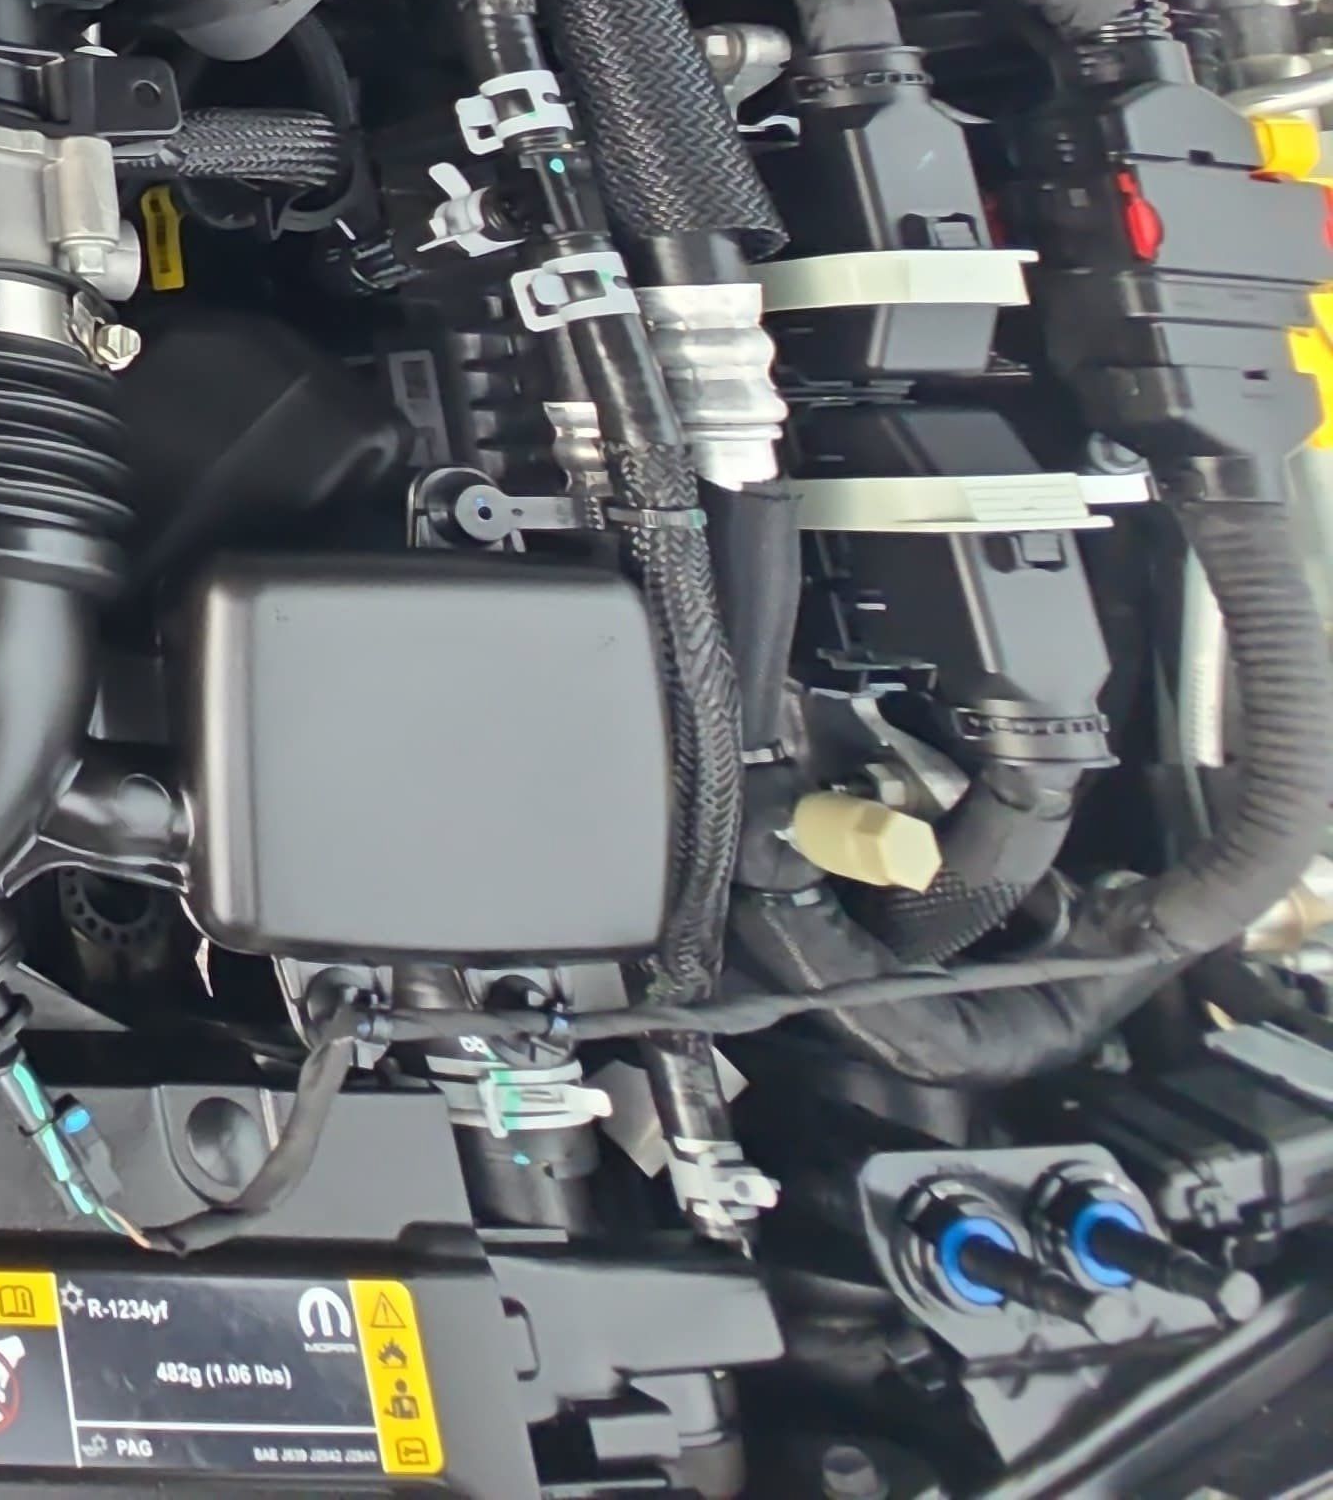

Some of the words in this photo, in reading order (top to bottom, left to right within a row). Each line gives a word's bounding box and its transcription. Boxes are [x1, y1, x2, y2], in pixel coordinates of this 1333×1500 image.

[86, 1297, 169, 1325] R-1234yf
[155, 1361, 203, 1389] 482g
[205, 1362, 251, 1389] (1.06
[255, 1363, 293, 1391] lbs)
[115, 1438, 154, 1458] PAG
